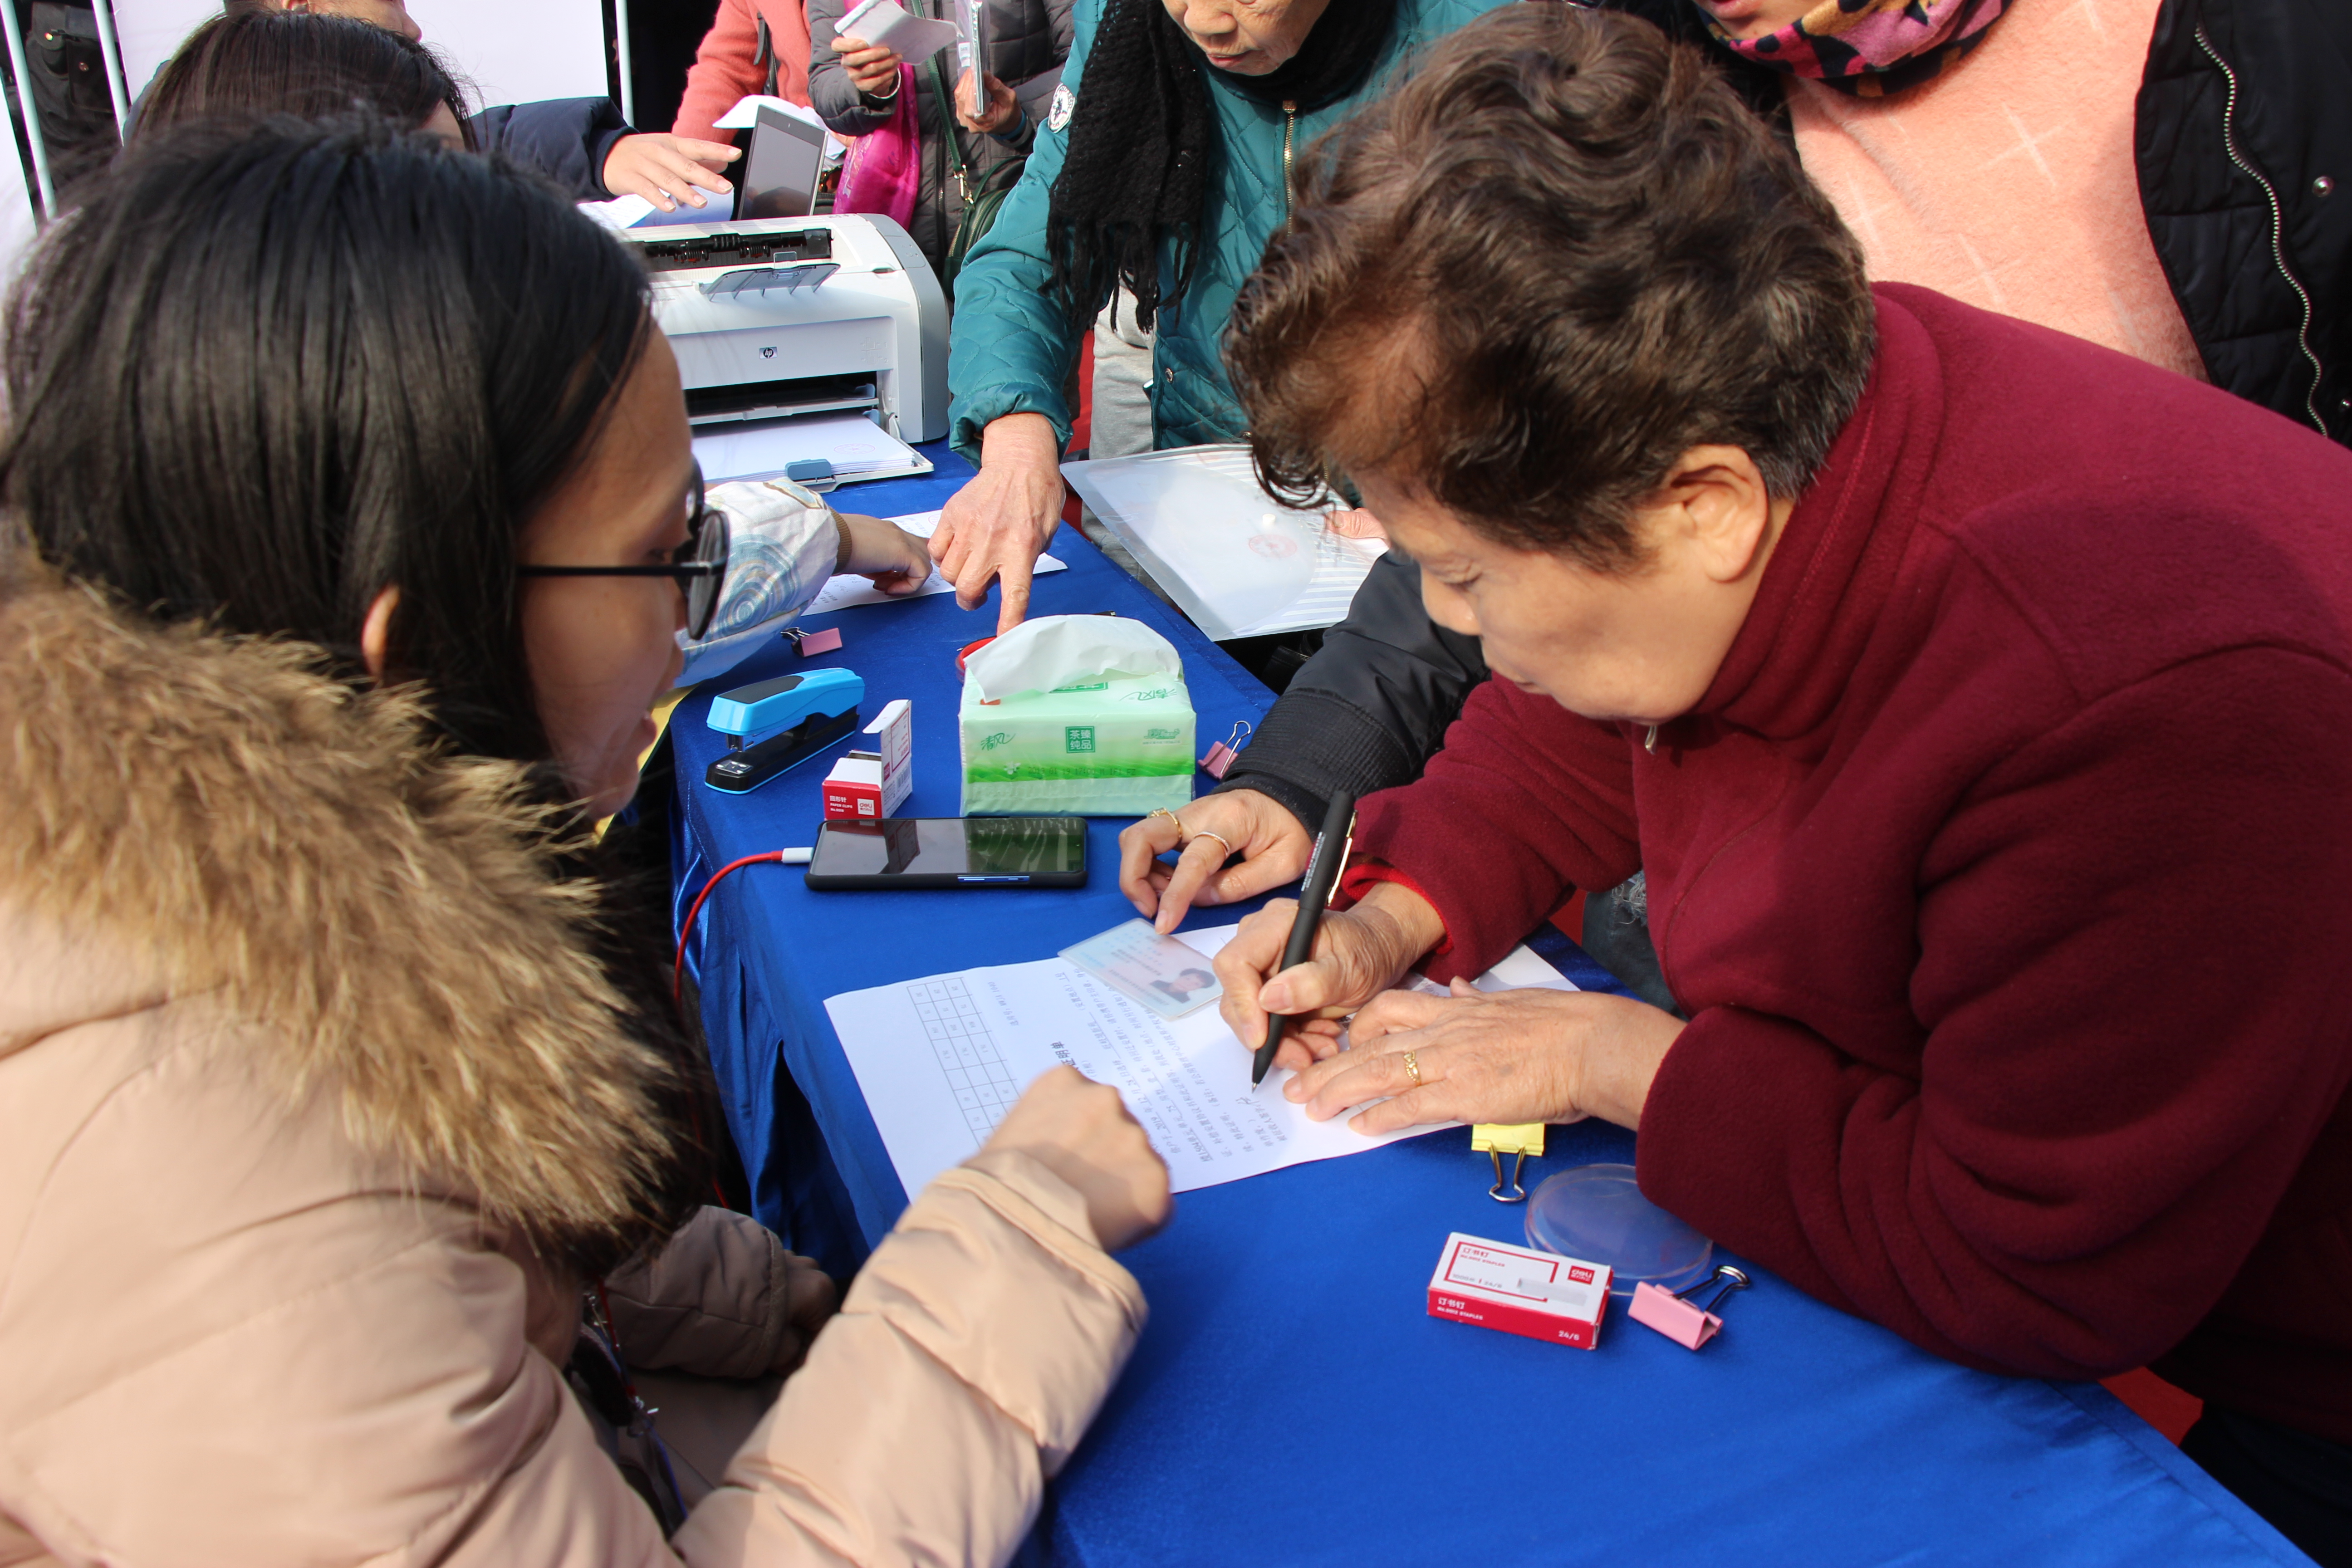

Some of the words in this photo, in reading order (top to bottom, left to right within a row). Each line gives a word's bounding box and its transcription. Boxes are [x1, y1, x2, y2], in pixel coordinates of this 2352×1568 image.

[1069, 730, 1092, 740] 茶臻
[980, 732, 1016, 751] 清风
[1070, 740, 1092, 750] 纯品
[1463, 1247, 1489, 1257] 订书钉
[1571, 1269, 1592, 1278] deli
[1438, 1297, 1465, 1309] 订书钉
[1558, 1330, 1580, 1341] 24/6
